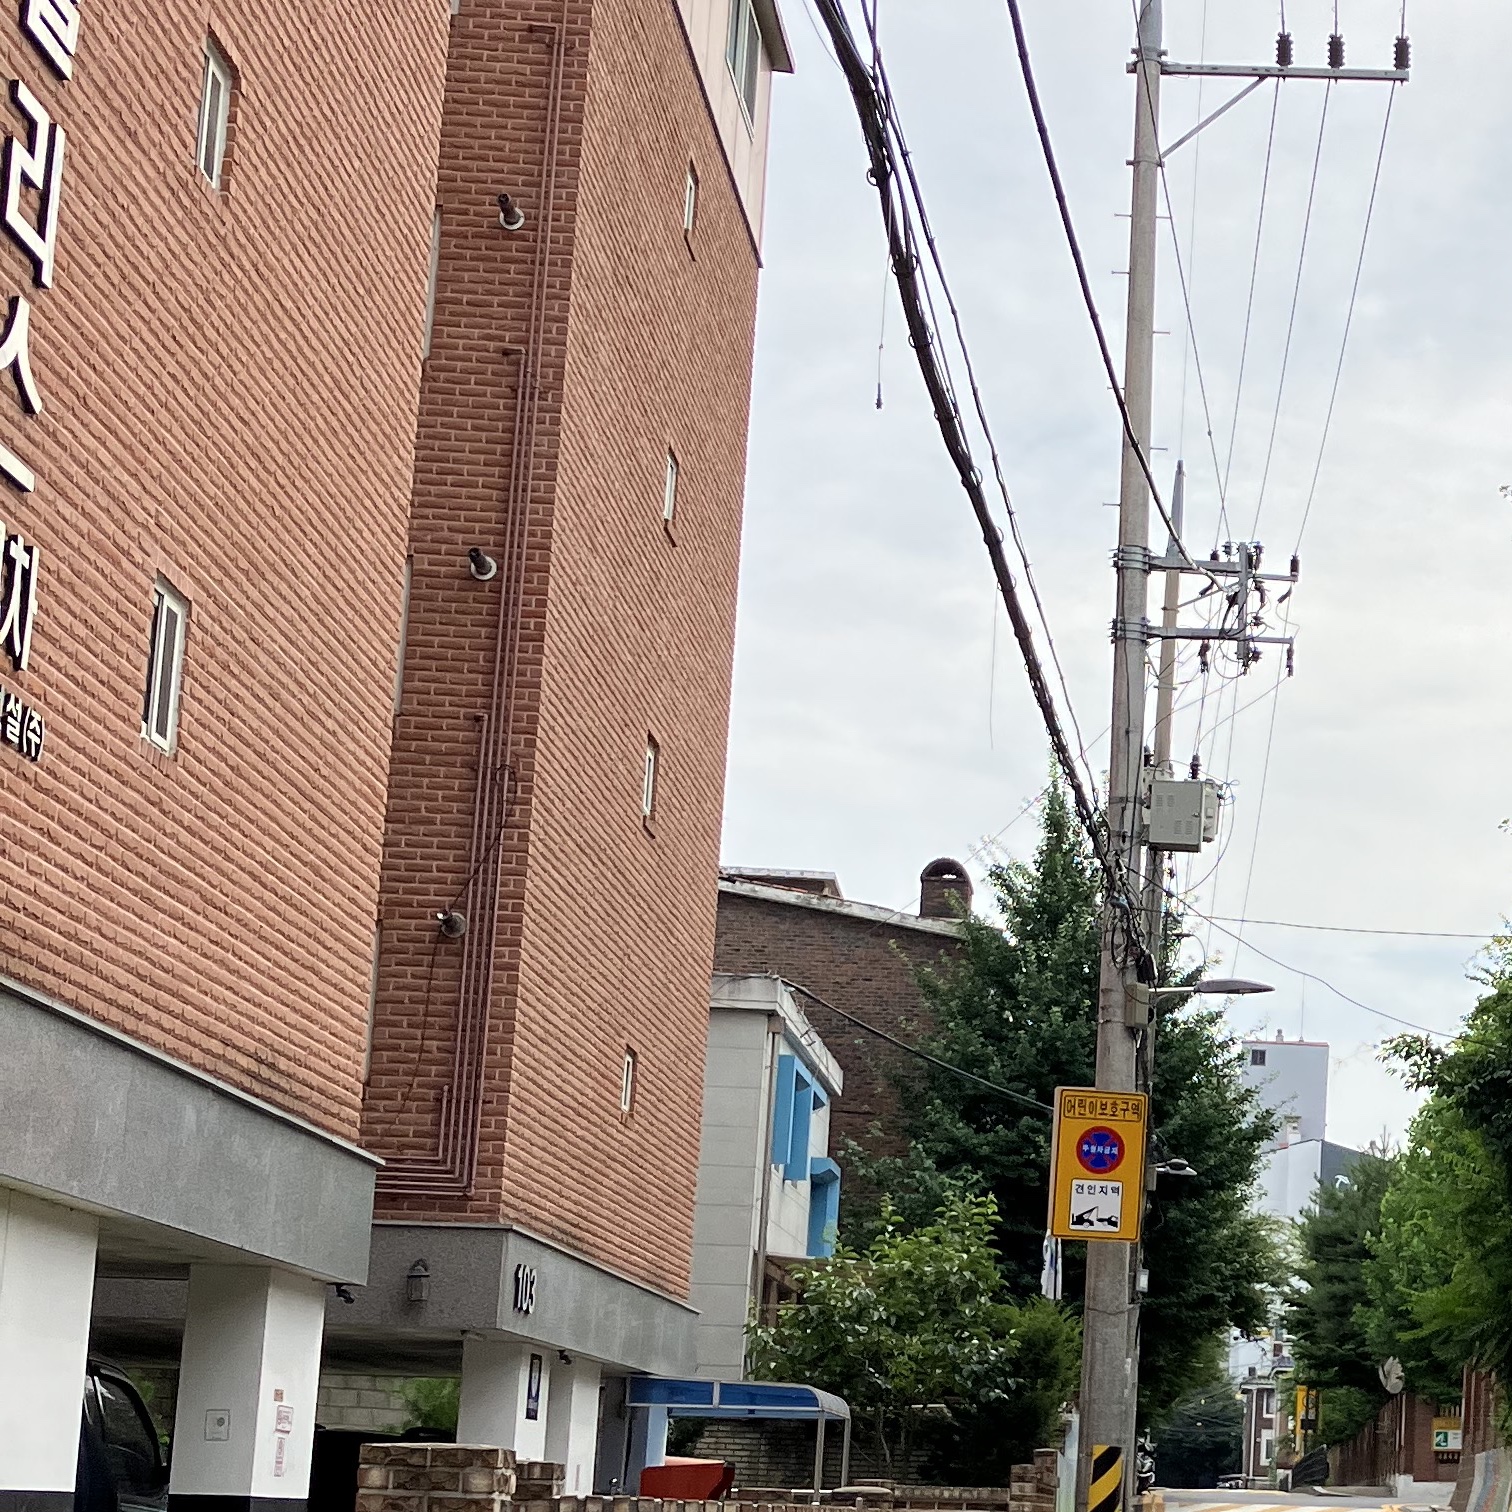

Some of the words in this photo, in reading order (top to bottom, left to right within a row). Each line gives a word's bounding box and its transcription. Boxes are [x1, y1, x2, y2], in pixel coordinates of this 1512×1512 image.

[1066, 1098, 1140, 1119] 어린이보호구역
[1075, 1183, 1120, 1196] 견인지역
[514, 1264, 537, 1315] 103
